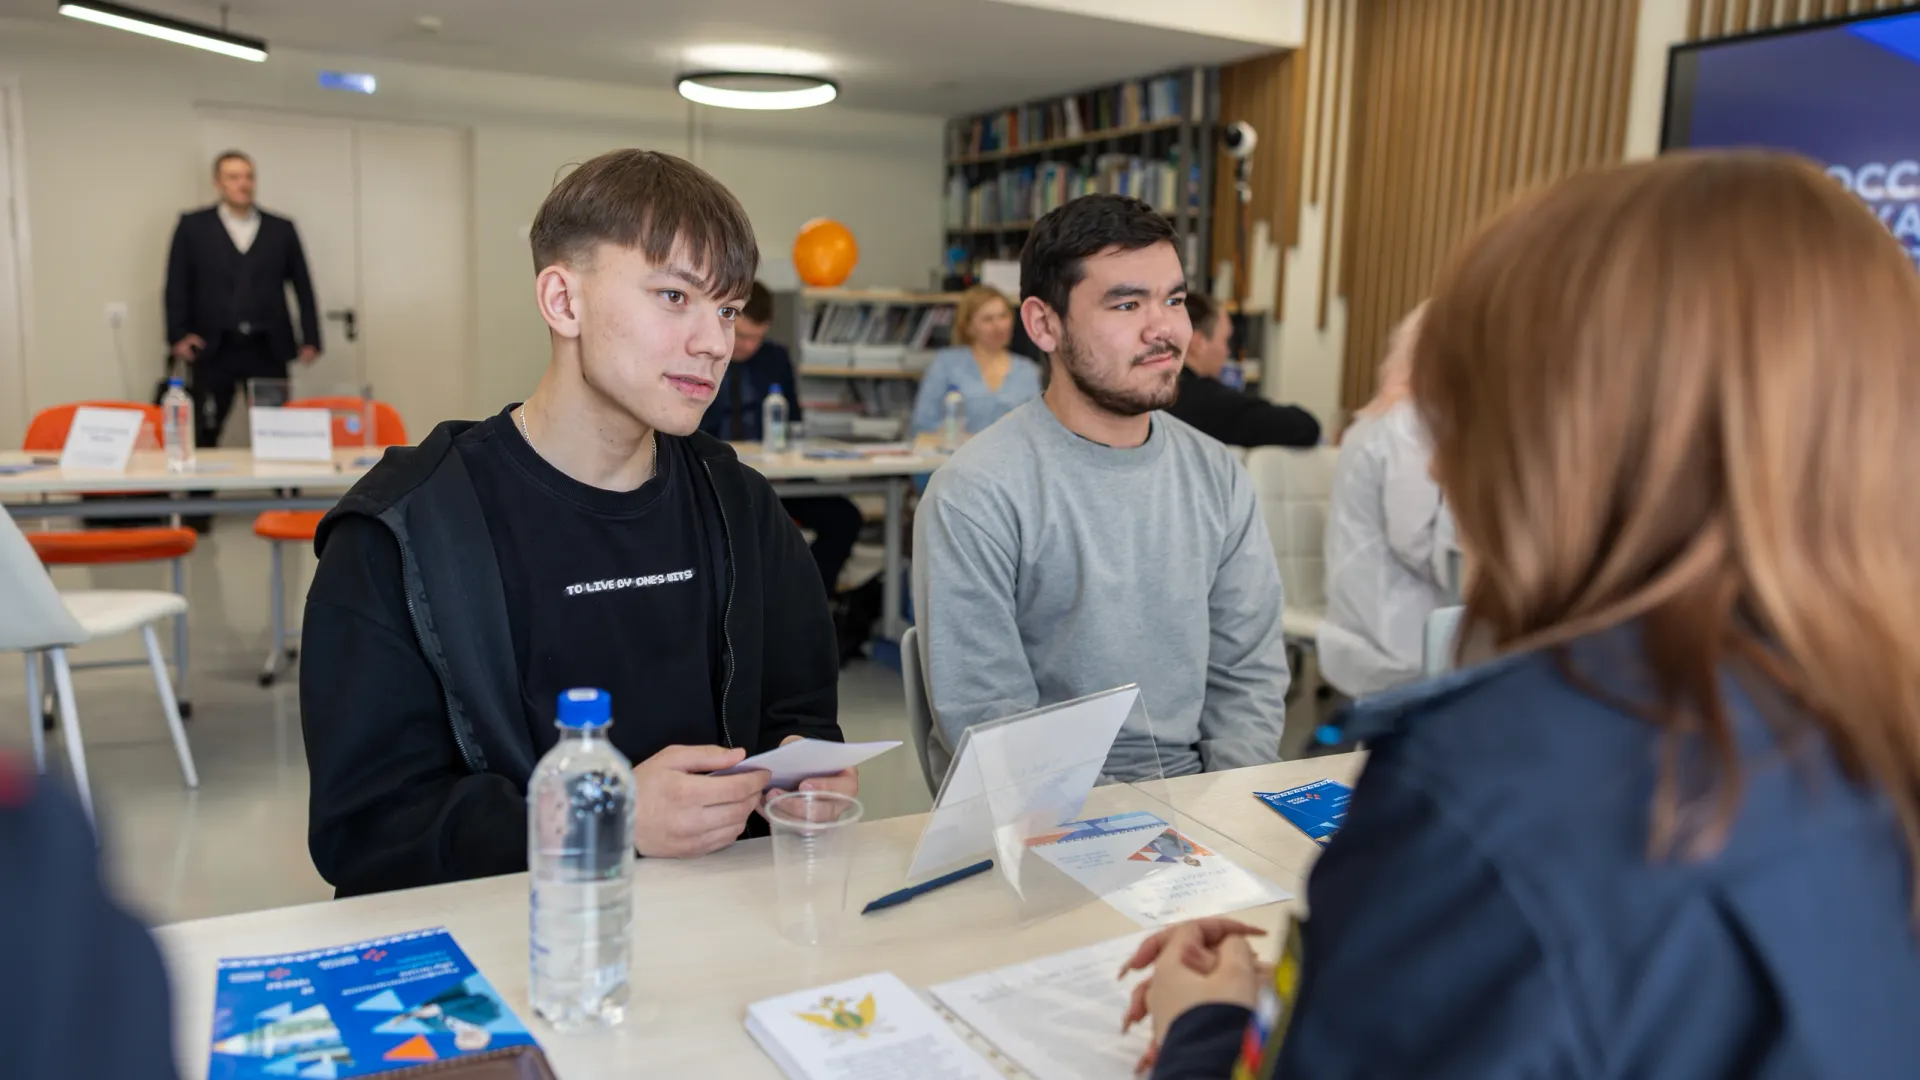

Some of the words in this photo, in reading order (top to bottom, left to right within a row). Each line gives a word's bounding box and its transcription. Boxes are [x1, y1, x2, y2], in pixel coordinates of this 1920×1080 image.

[566, 584, 583, 595] TO
[586, 579, 615, 592] LIVE
[616, 577, 632, 588] BY
